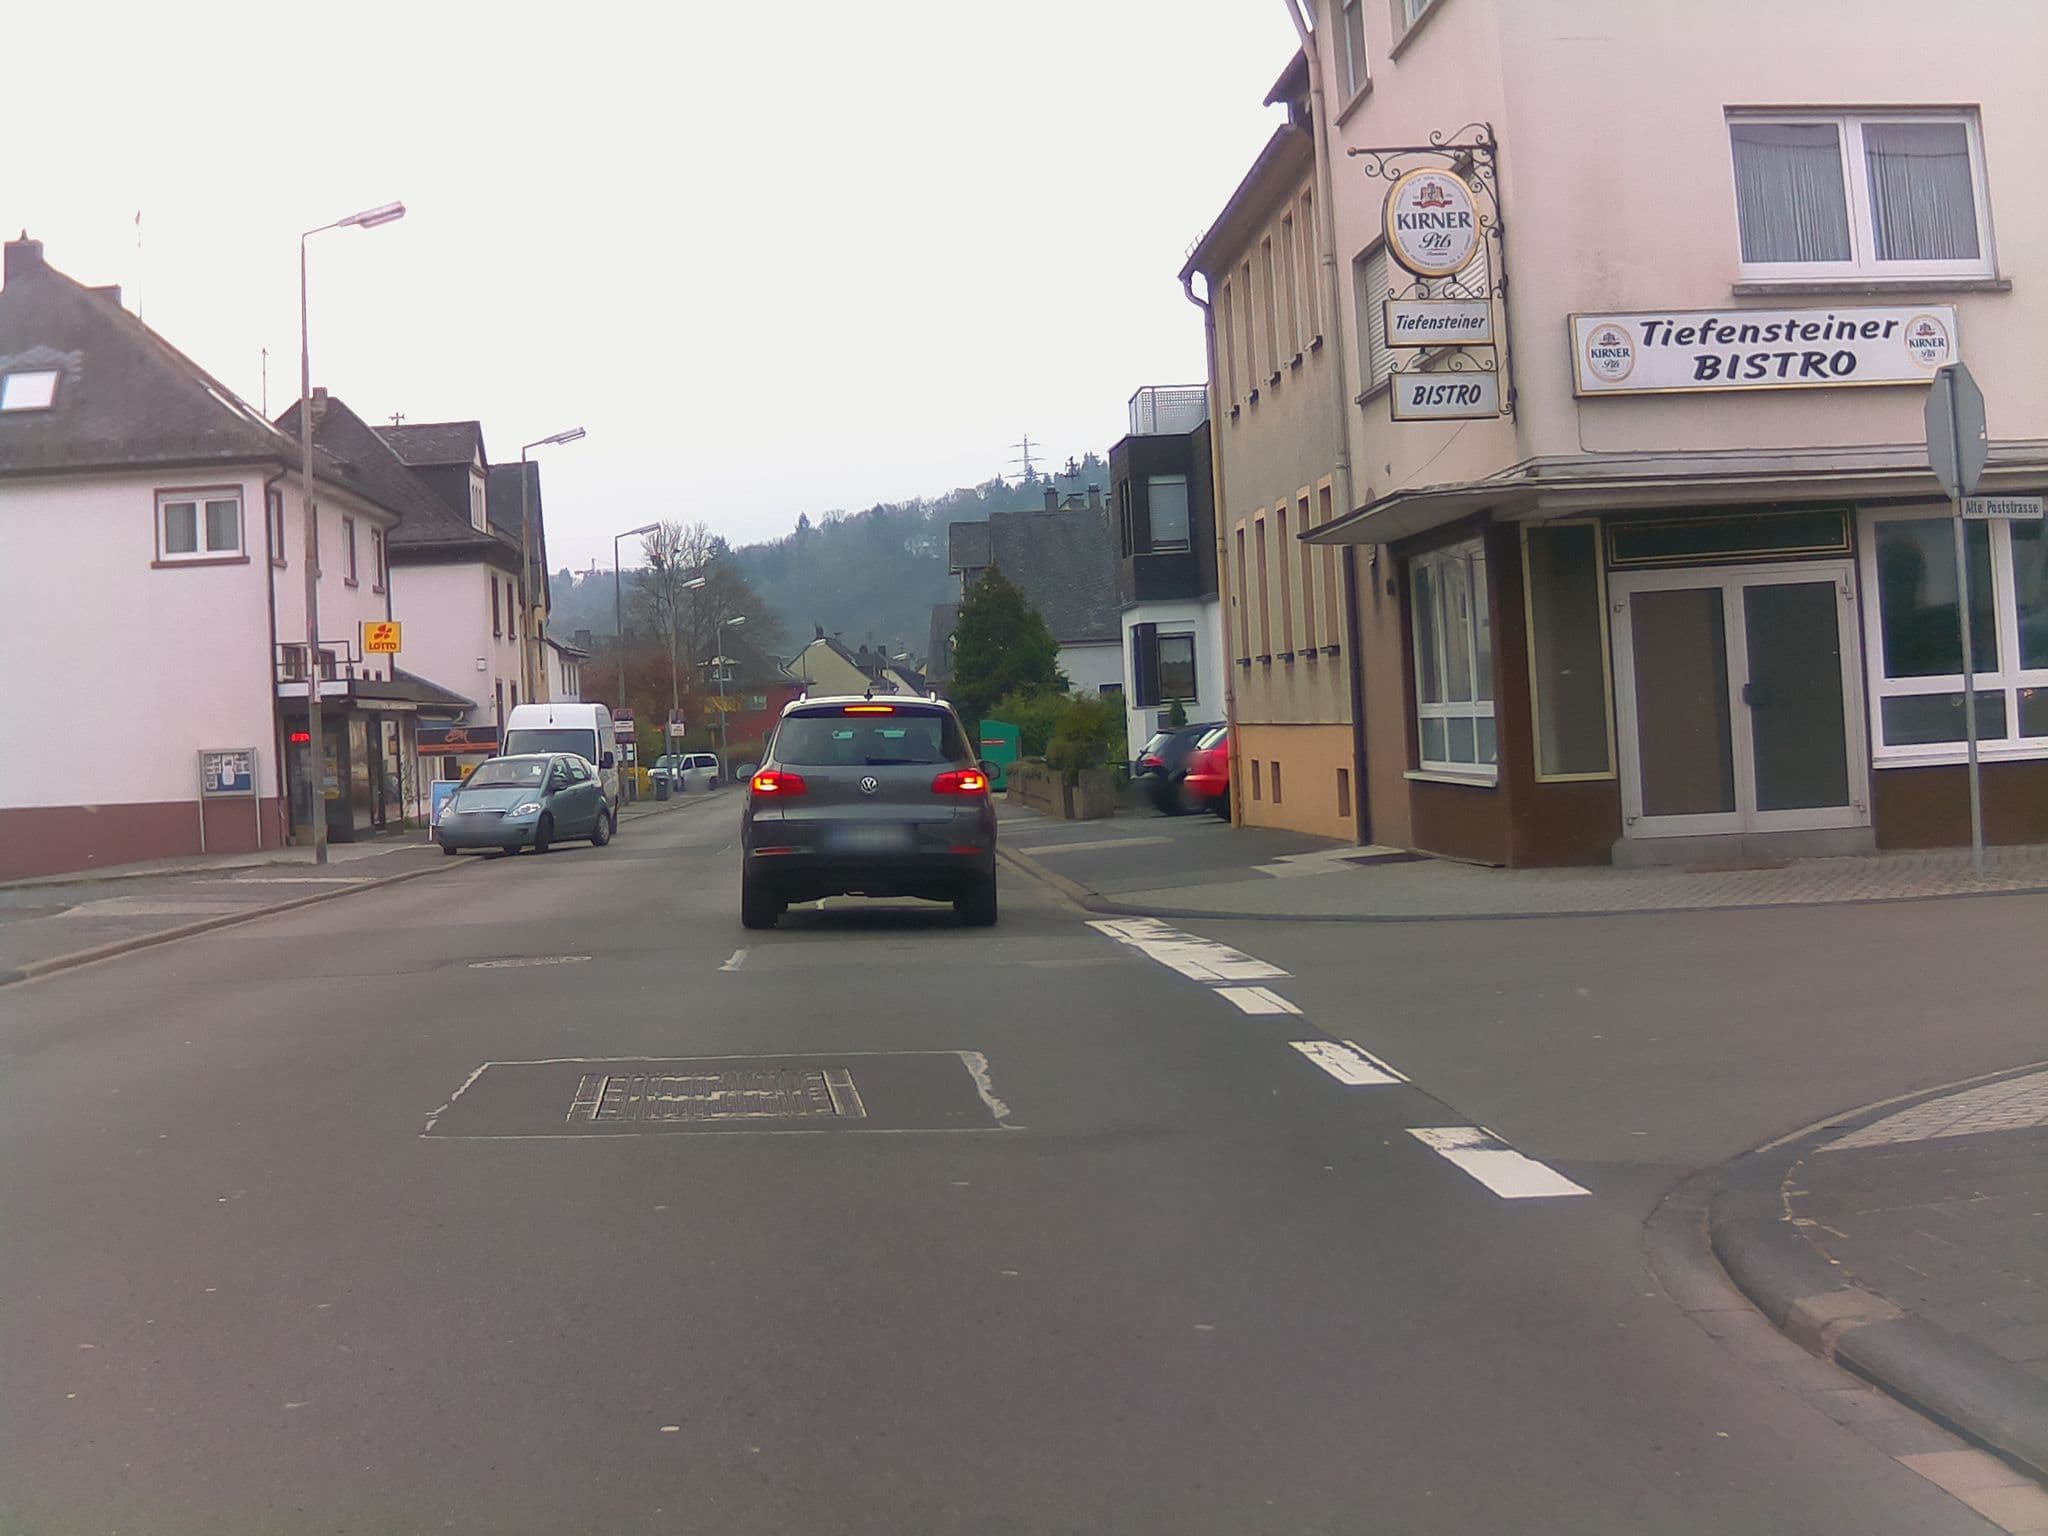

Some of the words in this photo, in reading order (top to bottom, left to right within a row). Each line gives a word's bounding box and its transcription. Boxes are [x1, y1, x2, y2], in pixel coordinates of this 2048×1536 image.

[1396, 211, 1473, 231] KIRNER
[1418, 231, 1452, 249] Pils
[1396, 313, 1486, 330] Tiefensteiner
[1639, 314, 1900, 347] Tiefensteiner
[1907, 337, 1945, 349] KIRNER
[1590, 347, 1631, 359] KIRNER
[1692, 350, 1857, 382] BISTRO
[1411, 384, 1482, 406] BISTRO
[1966, 500, 1983, 514] Alte
[1986, 500, 2040, 514] Poststrasse
[368, 641, 398, 650] LOTTO
